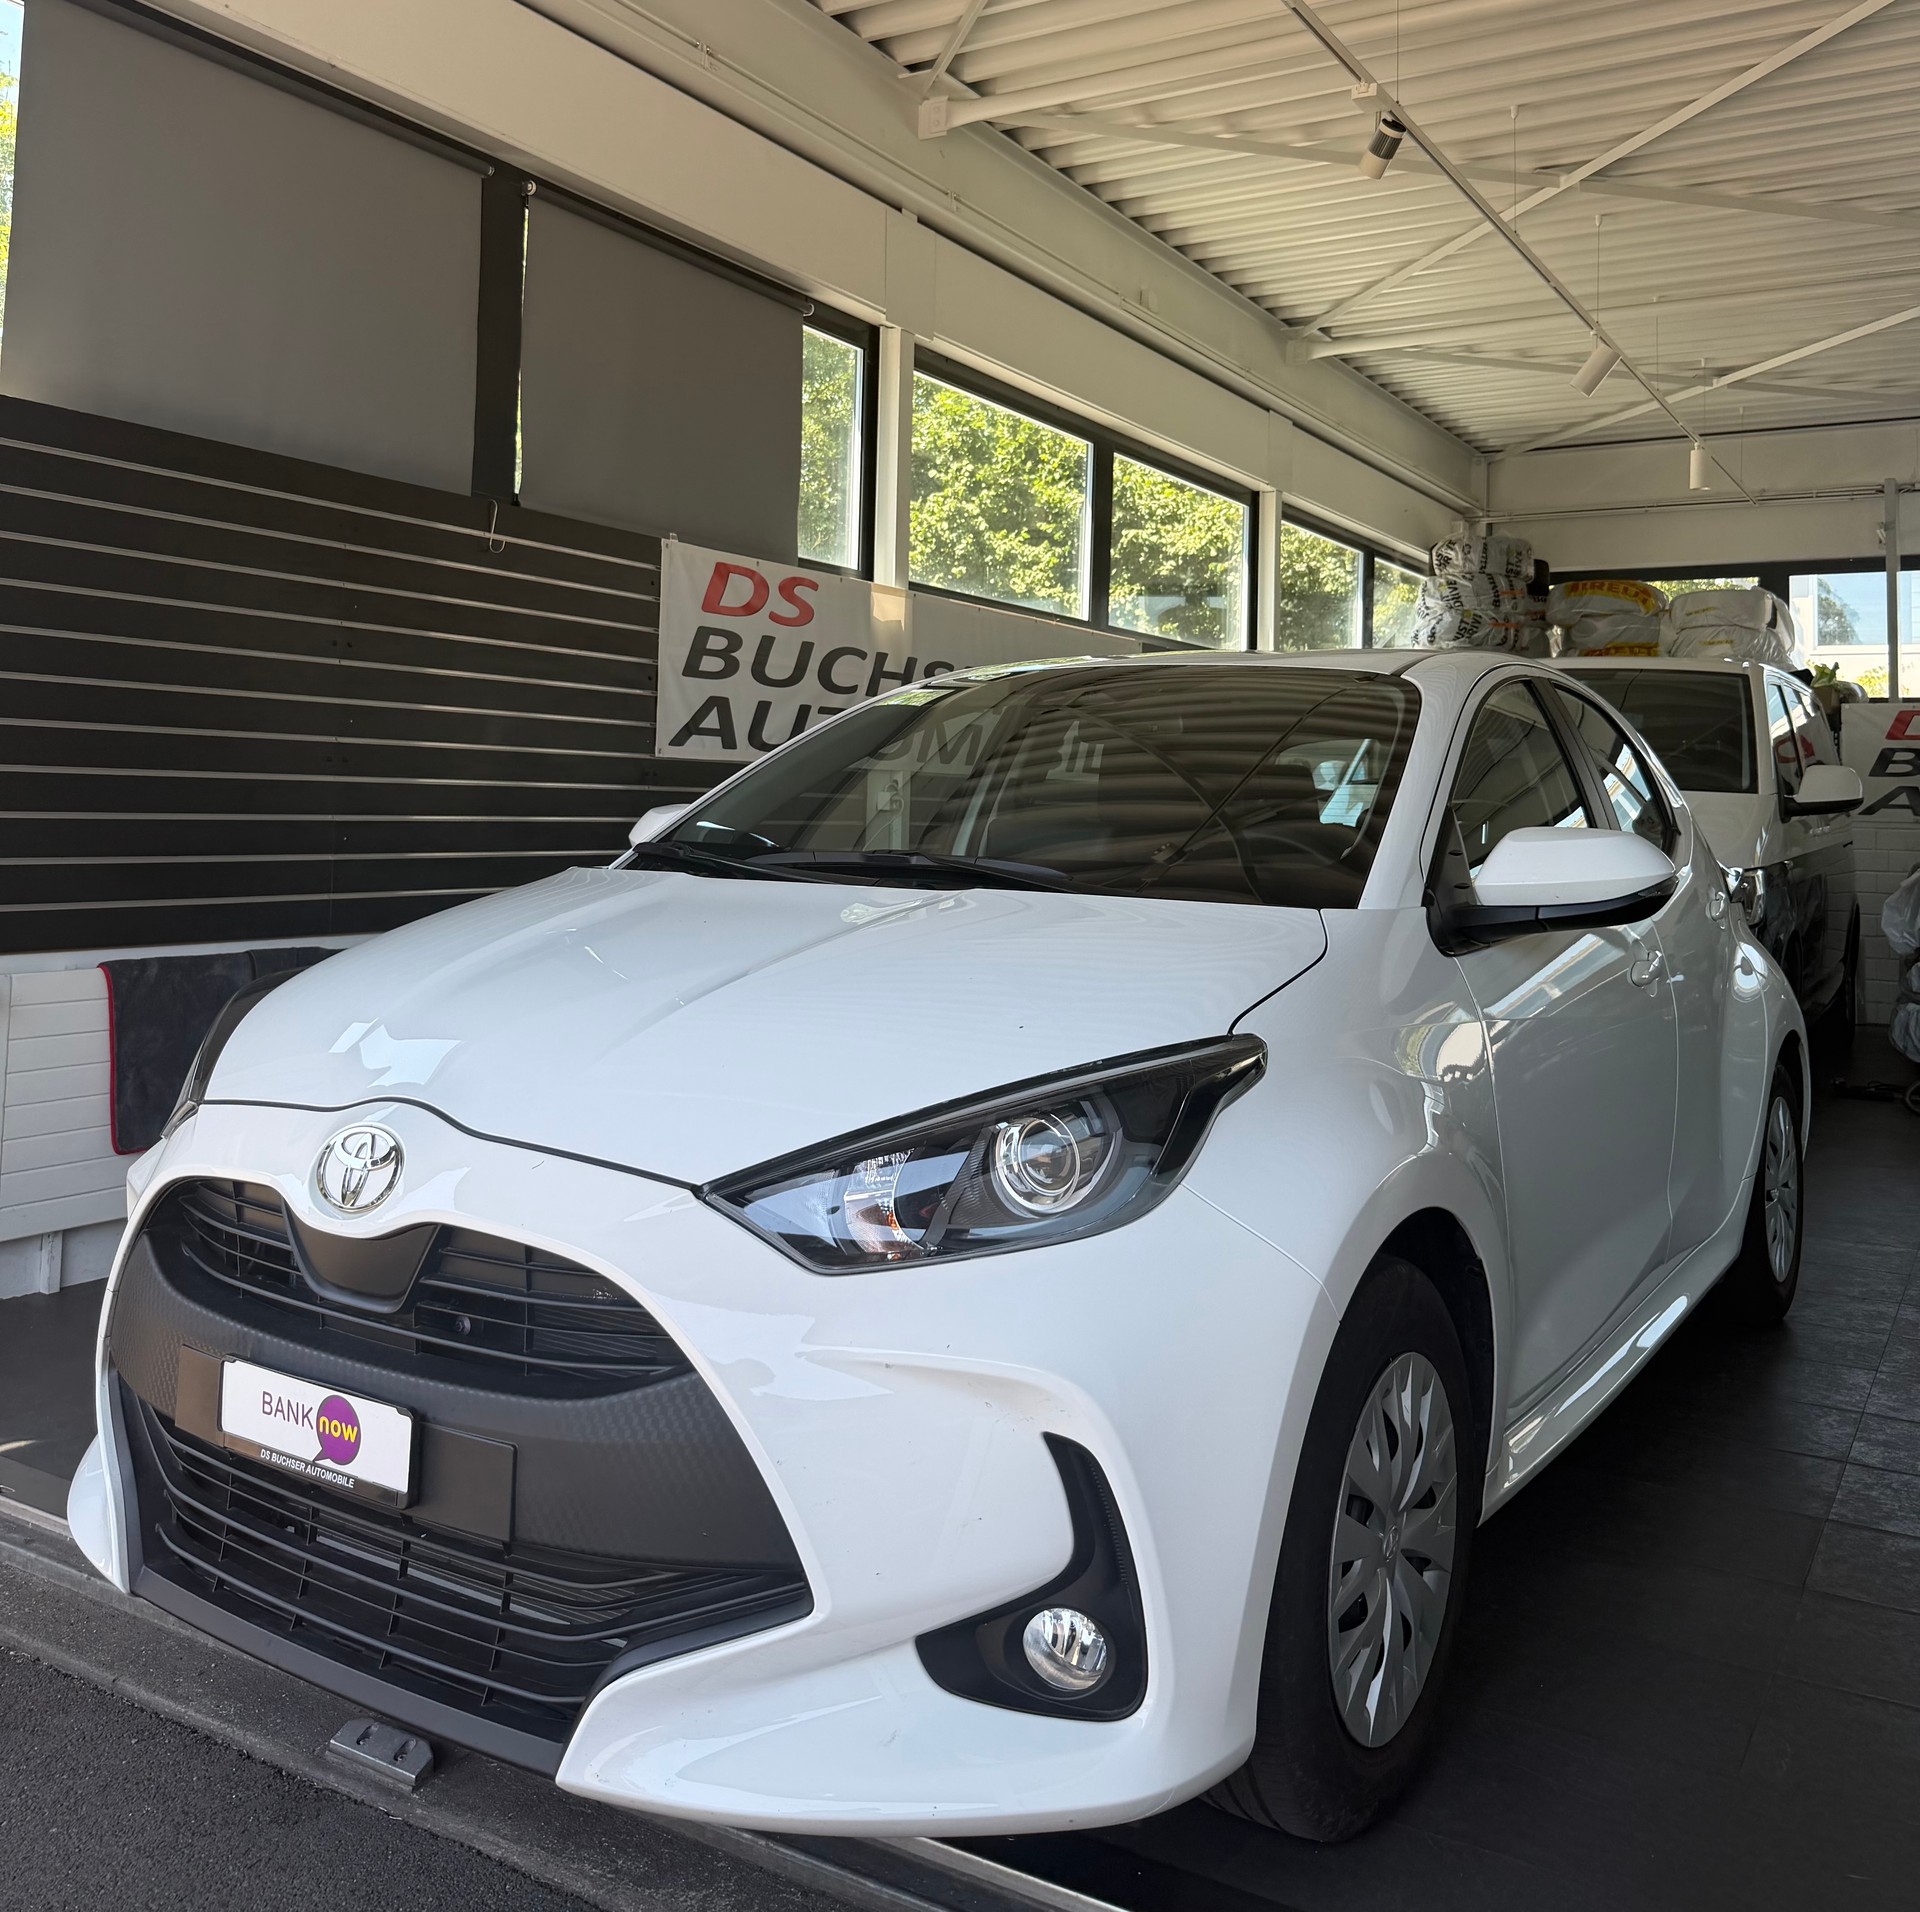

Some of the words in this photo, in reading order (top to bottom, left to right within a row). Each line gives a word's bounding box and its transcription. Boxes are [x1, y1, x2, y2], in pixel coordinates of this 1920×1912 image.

[701, 561, 820, 627] DS
[262, 1391, 314, 1430] BANK
[319, 1416, 358, 1443] now
[260, 1448, 271, 1460] DS
[271, 1452, 305, 1473] BUCHSER
[305, 1464, 355, 1488] AUTOMOBILE
